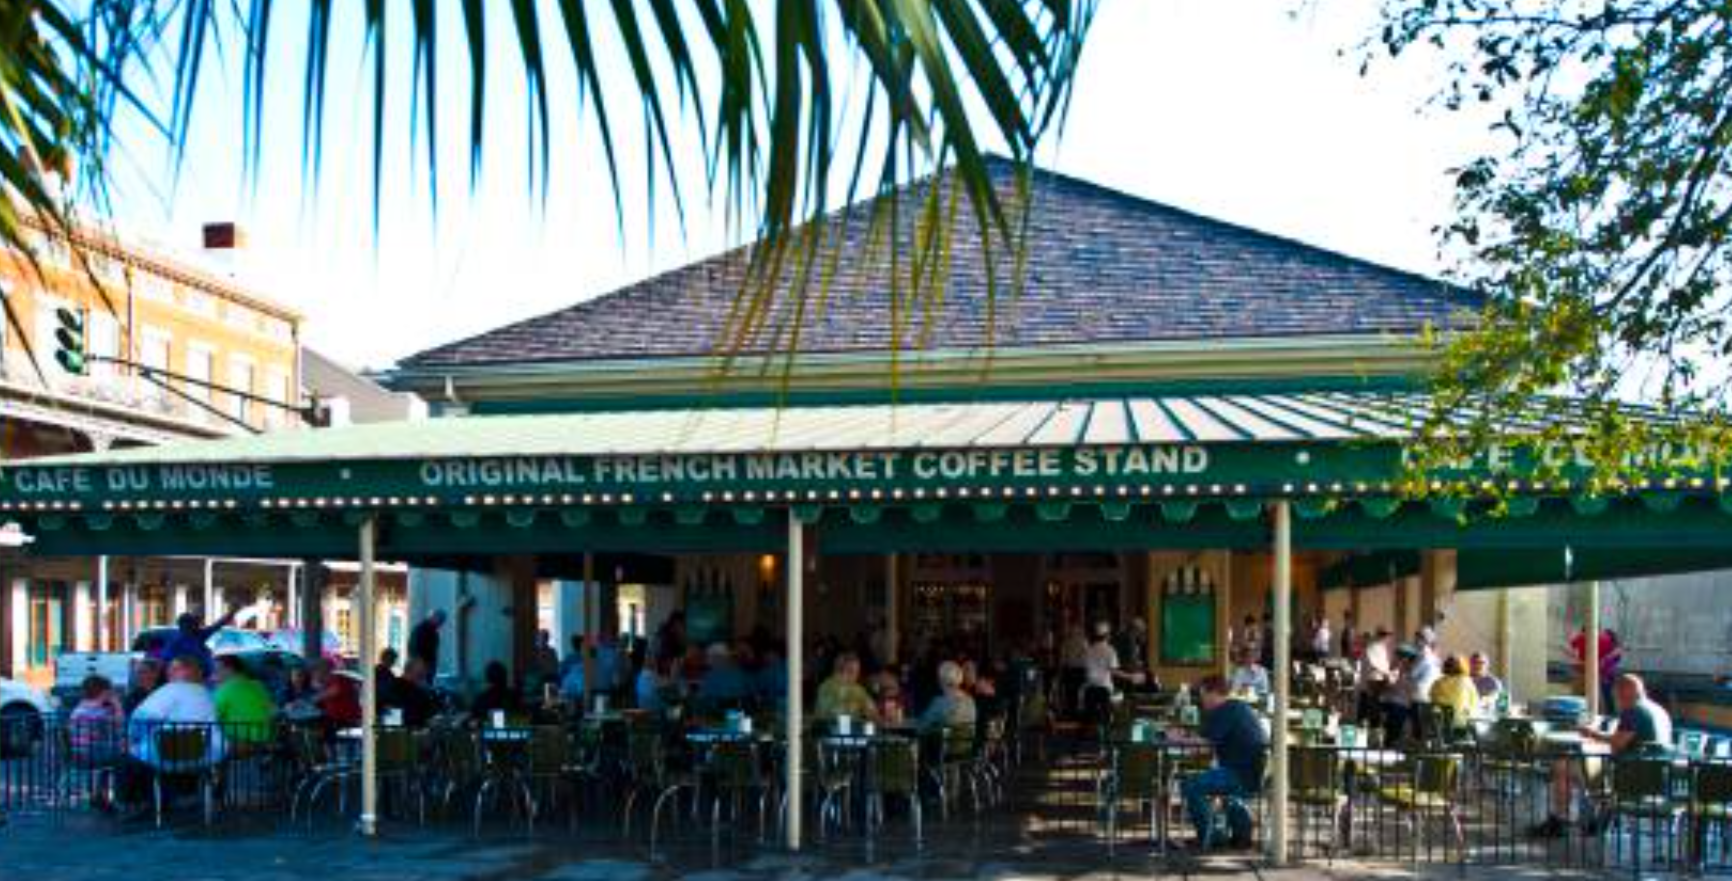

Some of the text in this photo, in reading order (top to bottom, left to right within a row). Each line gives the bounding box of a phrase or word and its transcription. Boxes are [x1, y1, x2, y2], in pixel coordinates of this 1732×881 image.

[14, 465, 274, 493] CAFE DU MONDE
[420, 446, 1209, 486] ORIGINAL FRENCH MARKET COFFEE STAND
